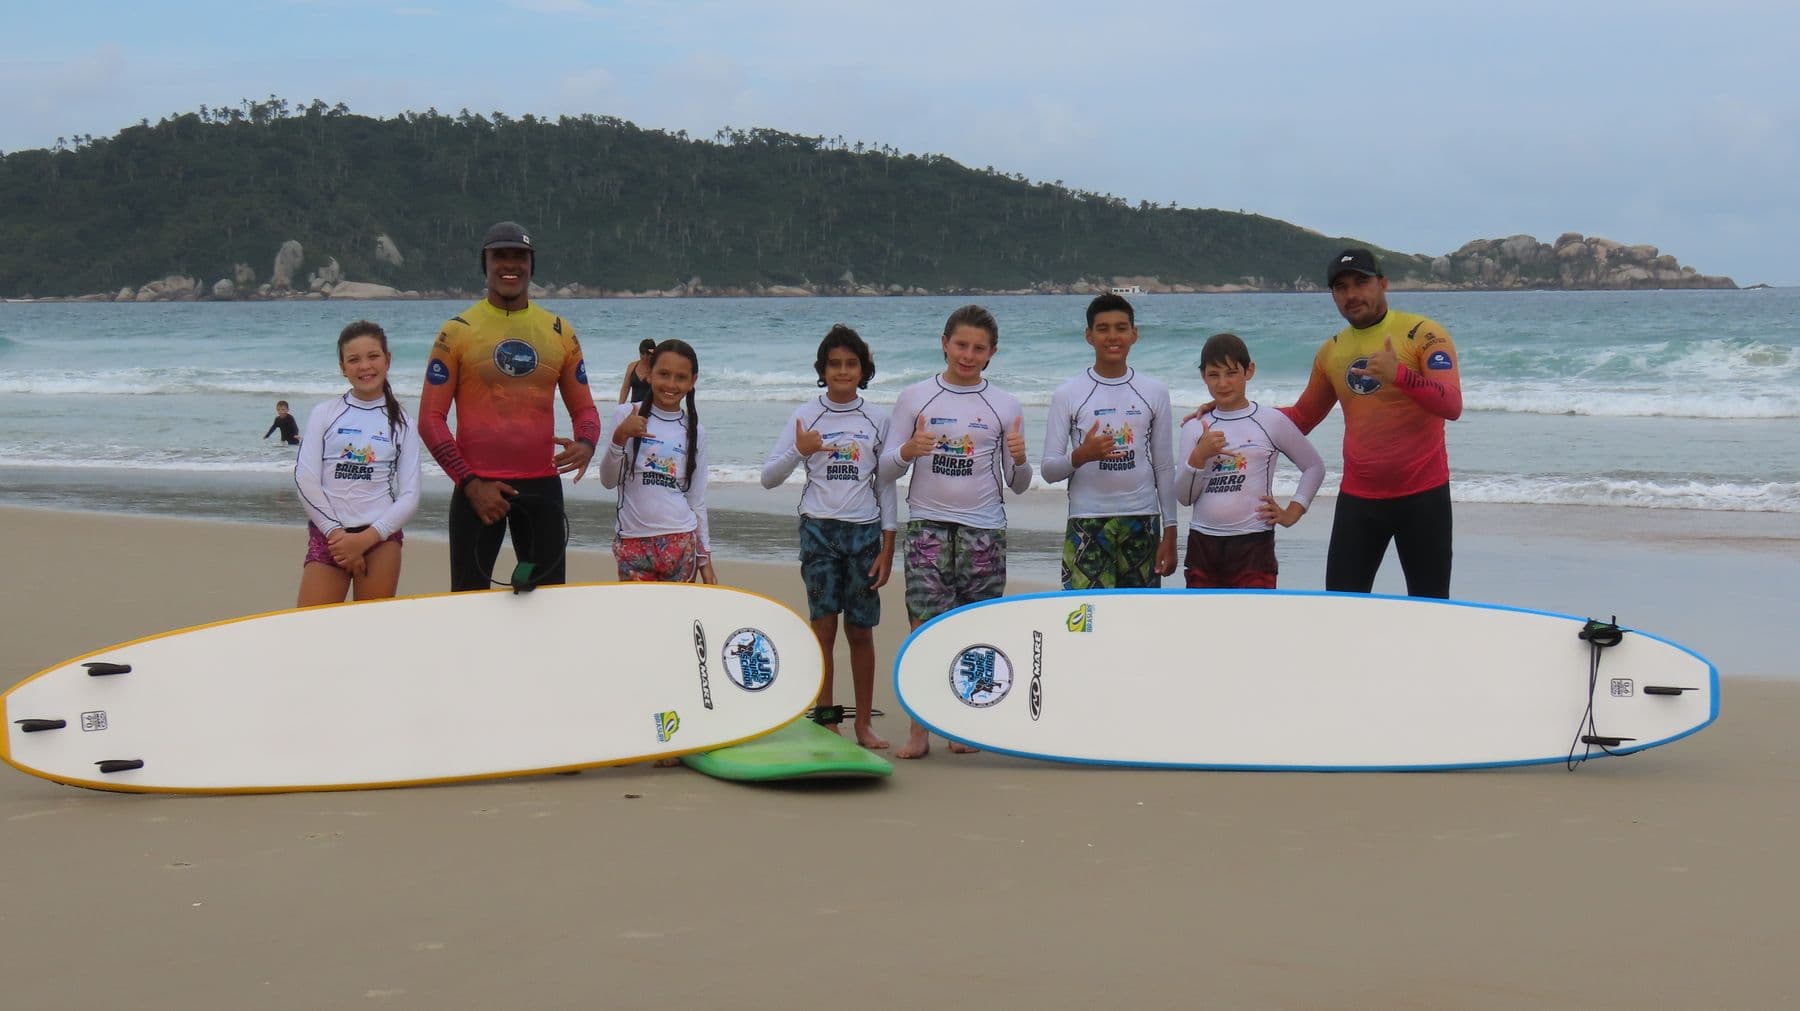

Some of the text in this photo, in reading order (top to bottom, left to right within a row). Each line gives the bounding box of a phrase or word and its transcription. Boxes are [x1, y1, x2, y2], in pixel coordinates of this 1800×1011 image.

[826, 464, 859, 475] BAIRRO
[932, 454, 974, 469] BAIRRO
[932, 465, 973, 477] EDUCADOR
[756, 652, 773, 684] JJR
[959, 651, 976, 682] JJR
[985, 650, 996, 686] SCHOOL
[1033, 630, 1042, 677] MARE
[740, 652, 754, 687] SCHOOL
